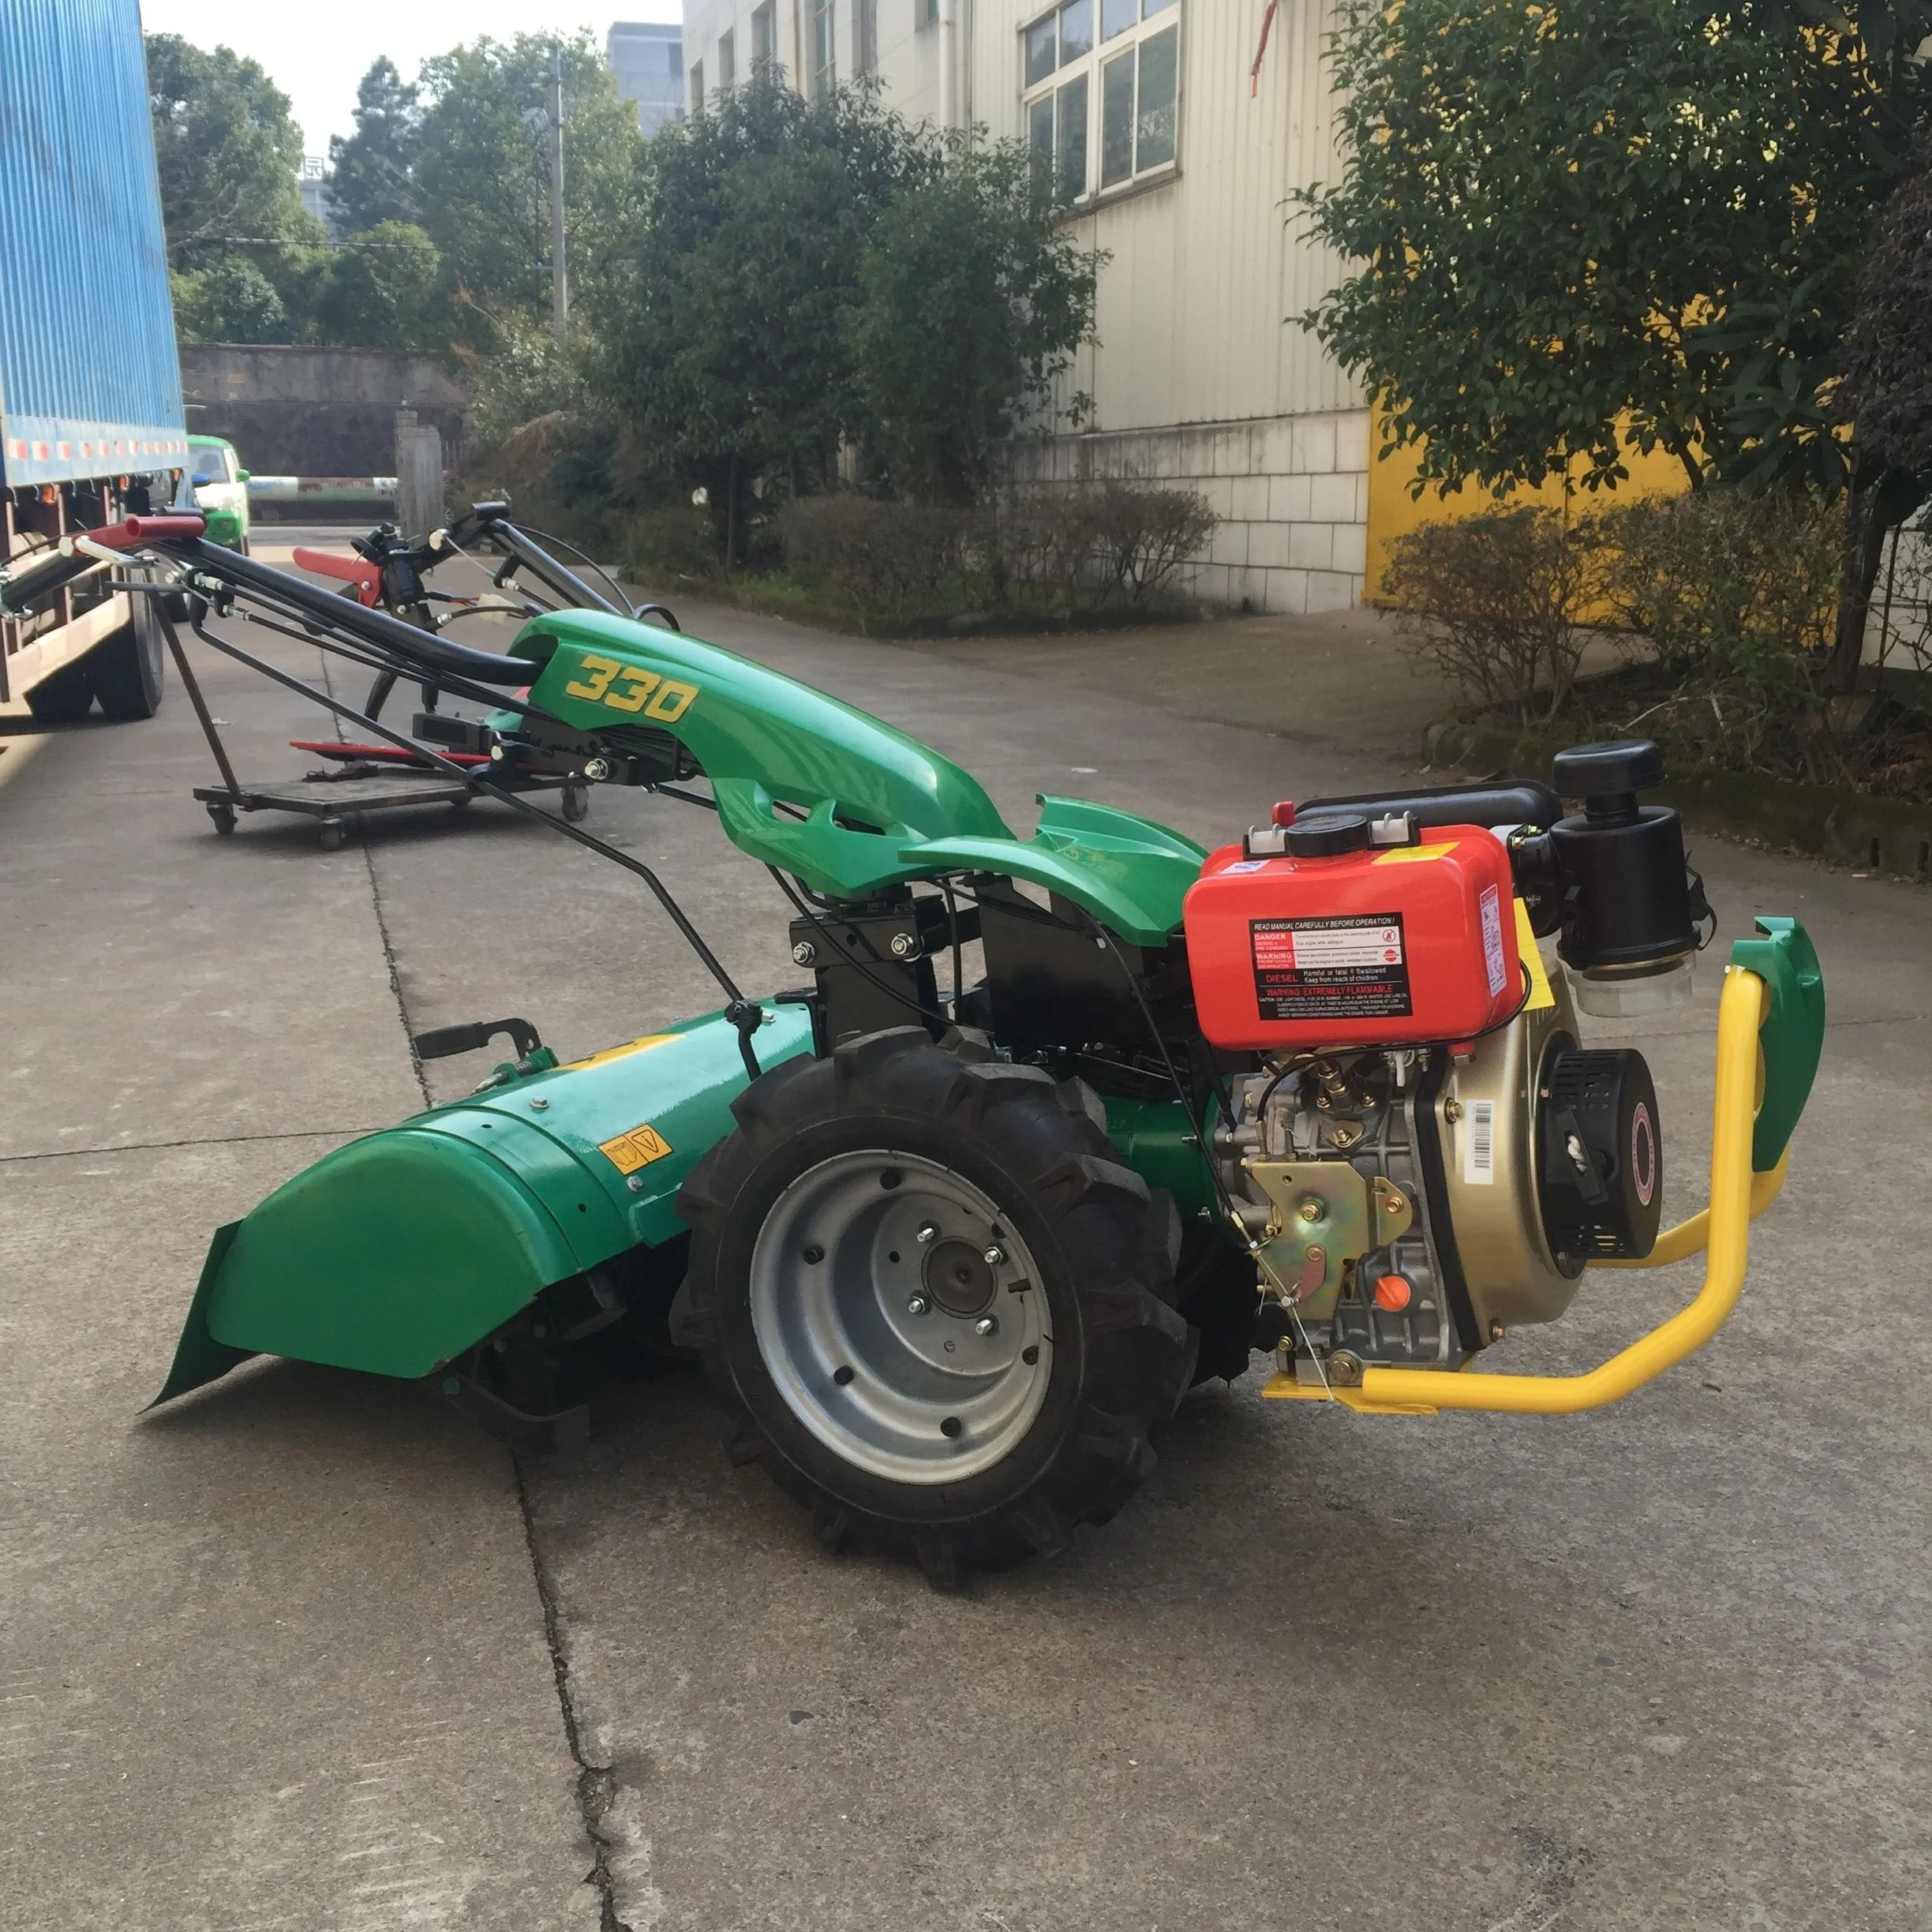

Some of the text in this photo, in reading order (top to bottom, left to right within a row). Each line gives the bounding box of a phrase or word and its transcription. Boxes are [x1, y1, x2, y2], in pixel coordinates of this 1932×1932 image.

[565, 655, 701, 724] 330
[1330, 919, 1355, 928] BEFORE
[1266, 975, 1298, 983] DIESEL
[1303, 986, 1346, 995] EXTREMELY
[1346, 984, 1393, 994] FLAMMABLE
